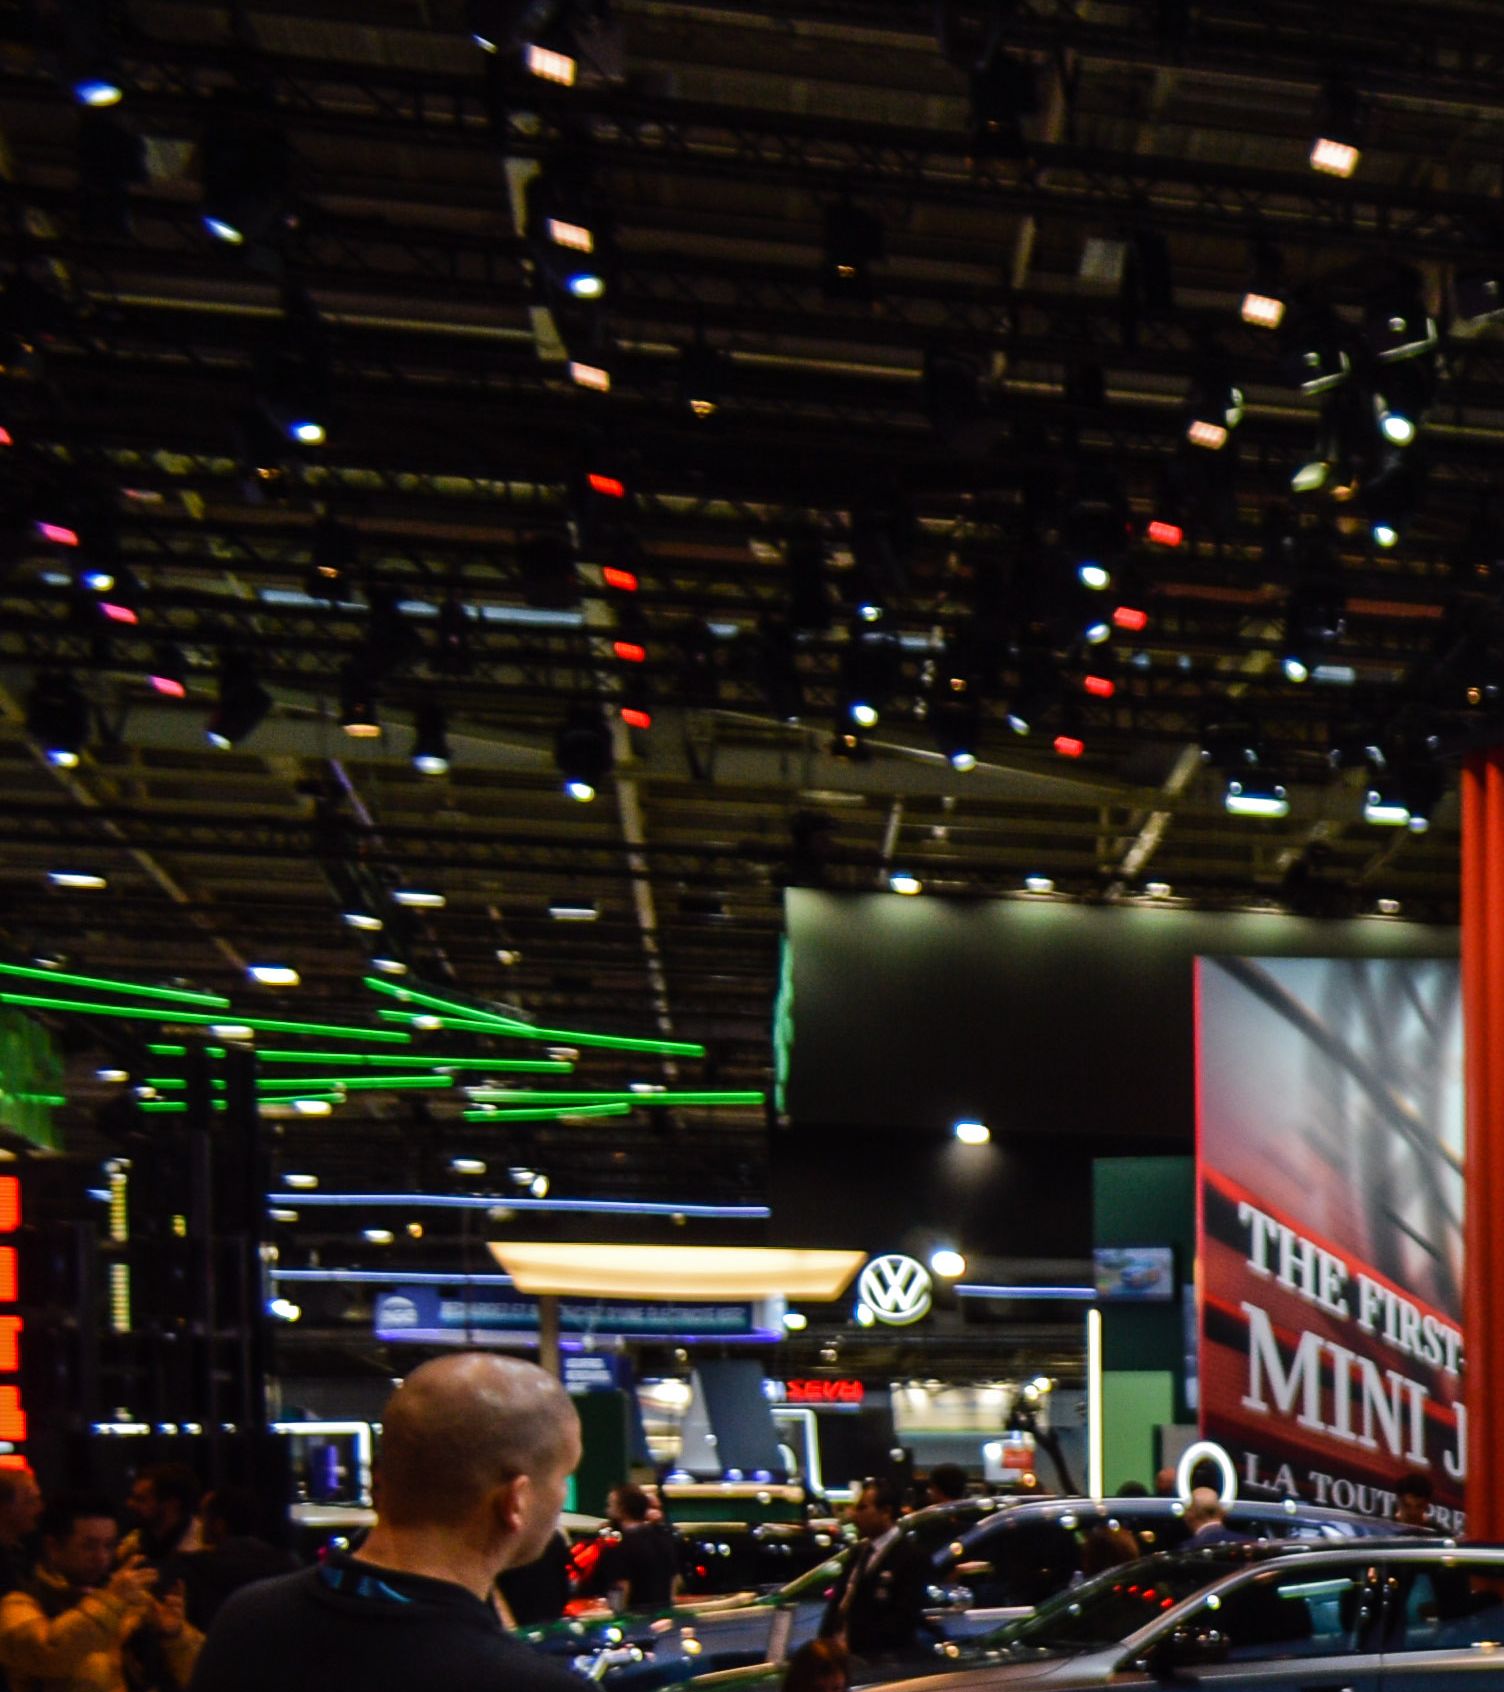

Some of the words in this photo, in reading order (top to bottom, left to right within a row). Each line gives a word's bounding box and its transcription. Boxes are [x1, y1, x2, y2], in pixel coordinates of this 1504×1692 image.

[1238, 1200, 1350, 1322] THE
[1241, 1300, 1430, 1467] MINI
[1243, 1451, 1300, 1498] LA
